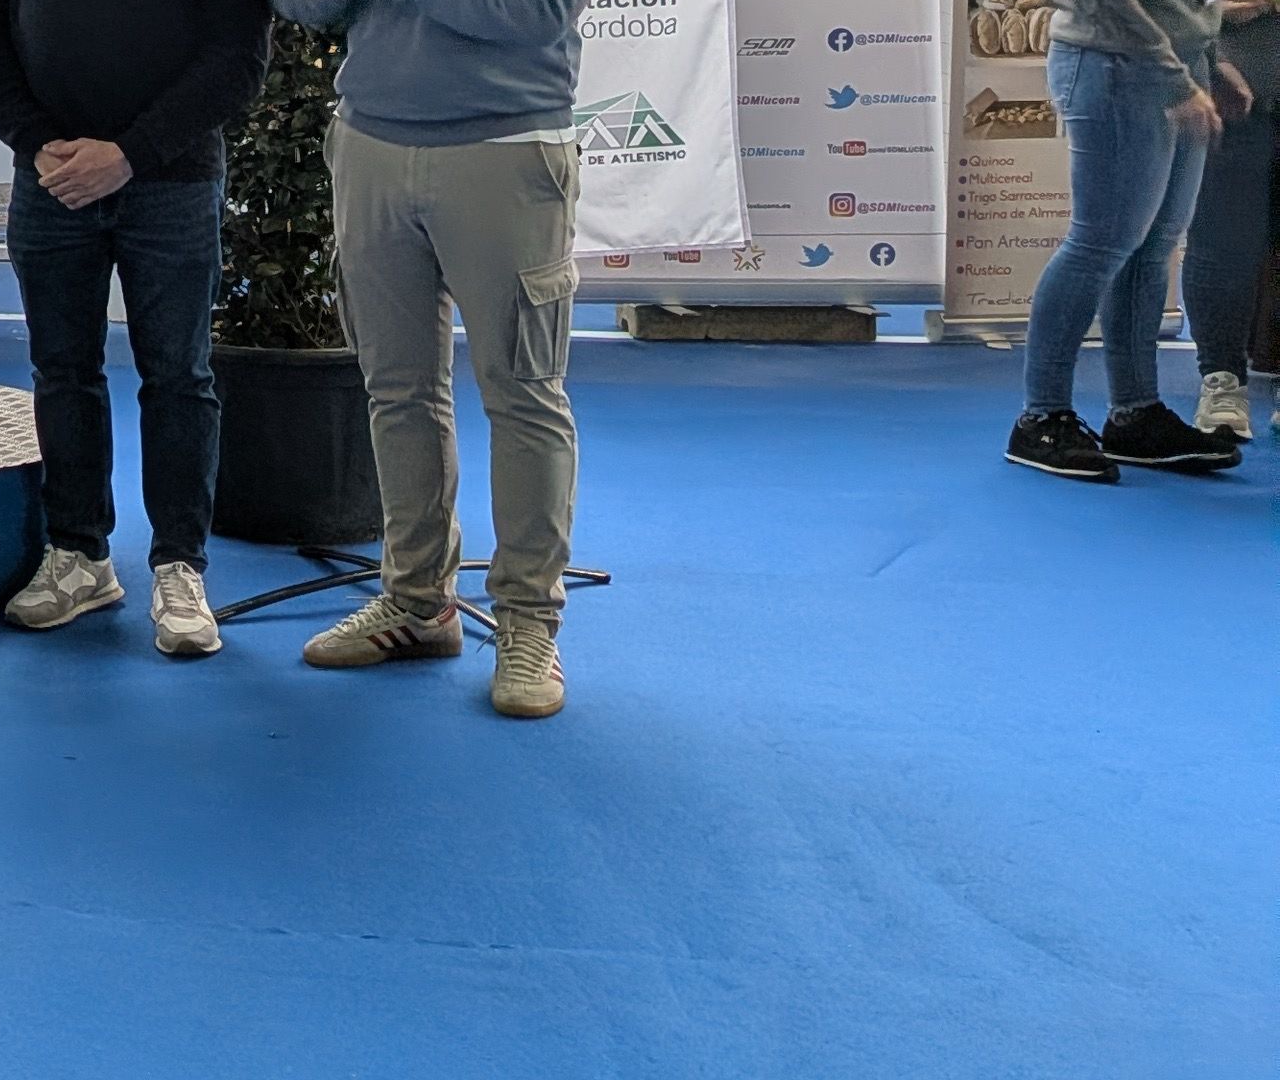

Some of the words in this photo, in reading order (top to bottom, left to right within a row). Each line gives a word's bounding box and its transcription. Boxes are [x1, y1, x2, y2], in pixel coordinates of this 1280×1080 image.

[581, 13, 678, 39] órdoba
[739, 37, 796, 50] SDM
[855, 33, 933, 46] @SDMlucena
[860, 93, 937, 106] @SDMlucena
[588, 155, 605, 165] DE
[611, 150, 687, 165] ATLETISMO
[740, 146, 805, 158] SDMlucena
[969, 155, 1014, 167] Quinoa
[969, 171, 1033, 185] Multicereal
[968, 191, 997, 205] Trigo
[857, 202, 936, 215] @SDMlucena
[967, 209, 1007, 221] Harina
[1010, 207, 1026, 219] de
[966, 235, 993, 249] Pan
